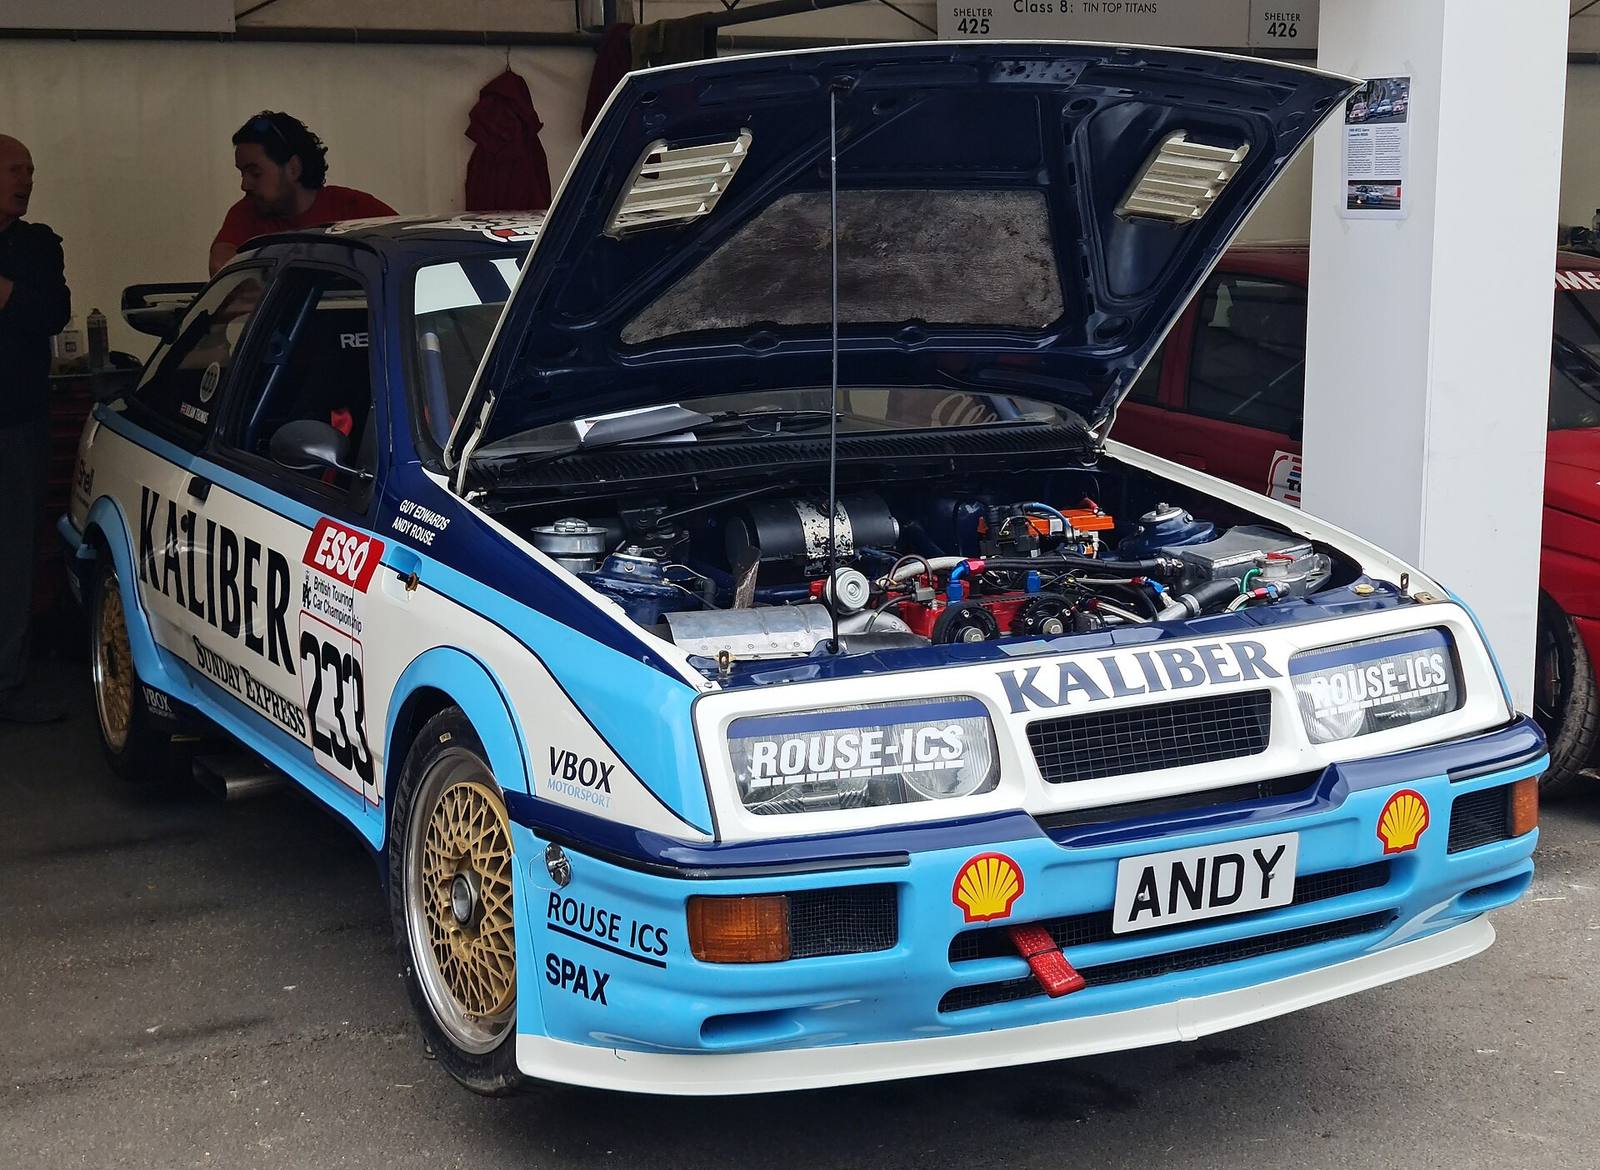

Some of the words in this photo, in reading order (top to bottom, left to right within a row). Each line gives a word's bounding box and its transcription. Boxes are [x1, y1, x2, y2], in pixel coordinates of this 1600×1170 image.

[953, 8, 993, 17] SHELTER
[957, 18, 990, 34] 425
[1013, 0, 1053, 13] Class
[1060, 0, 1073, 13] 8:
[1083, 3, 1099, 13] TIN
[1102, 3, 1123, 13] TOP
[1125, 2, 1157, 14] TITANS
[1264, 12, 1301, 22] SHELTER
[1267, 22, 1297, 38] 426
[391, 516, 413, 534] ANDY
[409, 523, 436, 546] ROUSE
[400, 499, 417, 515] GUY
[413, 505, 451, 531] EDWARDS
[314, 526, 370, 581] ESSO
[139, 485, 297, 676] KALIBER
[313, 575, 331, 598] British
[332, 584, 354, 612] Touring
[312, 593, 323, 611] Car
[192, 634, 241, 695] SUNDAY
[240, 669, 307, 739] EXPRESS
[995, 640, 1283, 715] KALIBER
[1311, 653, 1447, 711] ROUSE-ICS
[142, 685, 173, 713] VBOX
[300, 631, 375, 786] 233
[549, 746, 615, 794] VBOX
[751, 724, 964, 778] ROUSE-ICS
[547, 778, 613, 809] MOTORSPORT
[1128, 845, 1286, 922] ANDY
[547, 891, 622, 943] ROUSE
[629, 919, 669, 956] ICS
[545, 952, 610, 1006] SPAX
